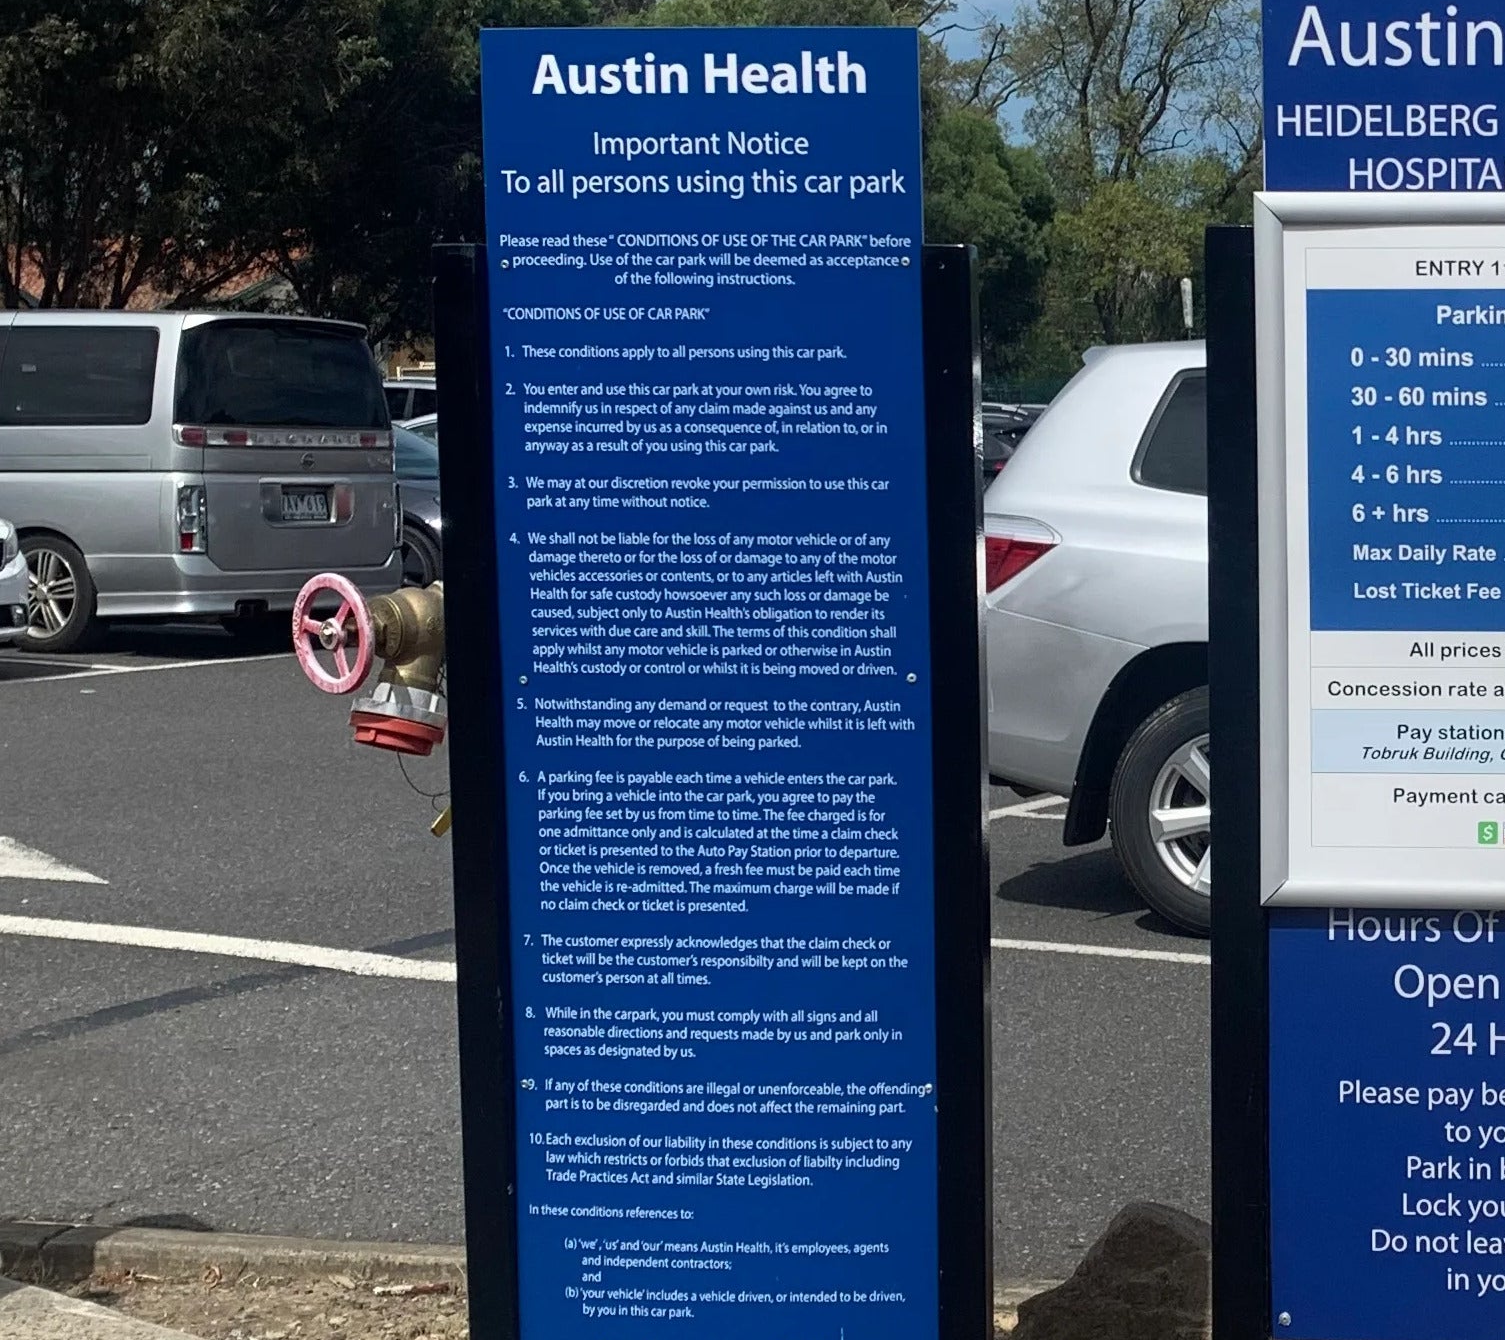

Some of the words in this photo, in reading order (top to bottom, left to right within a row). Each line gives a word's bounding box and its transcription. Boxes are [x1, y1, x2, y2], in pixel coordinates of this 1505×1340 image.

[1288, 5, 1502, 66] Austin
[532, 53, 688, 94] Austin
[704, 51, 866, 93] Health
[1278, 105, 1497, 136] HEIDELBERG
[594, 132, 720, 160] Important
[728, 132, 808, 154] Notice
[501, 170, 530, 193] To
[537, 169, 564, 193] all
[573, 176, 669, 199] persons
[677, 170, 744, 199] using
[751, 169, 797, 193] this
[805, 176, 842, 193] car
[850, 169, 905, 199] park
[1416, 260, 1484, 276] ENTRY
[505, 346, 514, 357] 1.
[522, 345, 556, 357] These
[559, 345, 619, 357] conditions
[622, 345, 655, 360] apply
[657, 347, 670, 357] to
[672, 345, 685, 357] all
[689, 349, 734, 360] persons
[738, 346, 769, 361] using
[772, 346, 794, 358] this
[797, 349, 815, 358] car
[818, 346, 846, 361] park.
[1351, 348, 1363, 366] 0
[1386, 348, 1411, 366] 30
[1419, 348, 1473, 366] mins
[1352, 387, 1376, 405] 30
[1399, 387, 1424, 405] 60
[1433, 387, 1487, 406] mins
[1352, 426, 1361, 444] 1
[1385, 426, 1399, 445] 4
[1407, 426, 1442, 445] hrs
[1351, 465, 1365, 483] 4
[1386, 465, 1398, 483] 6
[1407, 465, 1442, 483] hrs
[1353, 504, 1365, 522] 6
[1393, 504, 1429, 522] hrs
[1354, 545, 1392, 560] Max
[1399, 545, 1446, 564] Daily
[1453, 545, 1496, 561] Rate
[1355, 583, 1396, 598] Lost
[1402, 583, 1461, 599] Ticket
[1467, 583, 1501, 599] Fee
[1410, 642, 1433, 657] All
[1441, 643, 1501, 661] prices
[1328, 681, 1441, 696] Concession
[1449, 682, 1487, 696] rate
[1398, 725, 1432, 743] Pay
[1363, 747, 1418, 759] Tobruk
[1423, 747, 1493, 763] Building,
[1394, 788, 1478, 807] Payment
[1329, 908, 1440, 942] Hours
[1453, 910, 1498, 942] Of
[1395, 964, 1499, 1007] Open
[1431, 1022, 1477, 1055] 24
[1340, 1080, 1419, 1104] Please
[1428, 1088, 1474, 1111] pay
[1445, 1122, 1471, 1142] to
[1408, 1156, 1461, 1179] Park
[1469, 1157, 1491, 1180] in
[1403, 1193, 1461, 1216] Lock
[1372, 1229, 1407, 1252] Do
[1416, 1233, 1459, 1253] not
[1448, 1268, 1469, 1290] in
